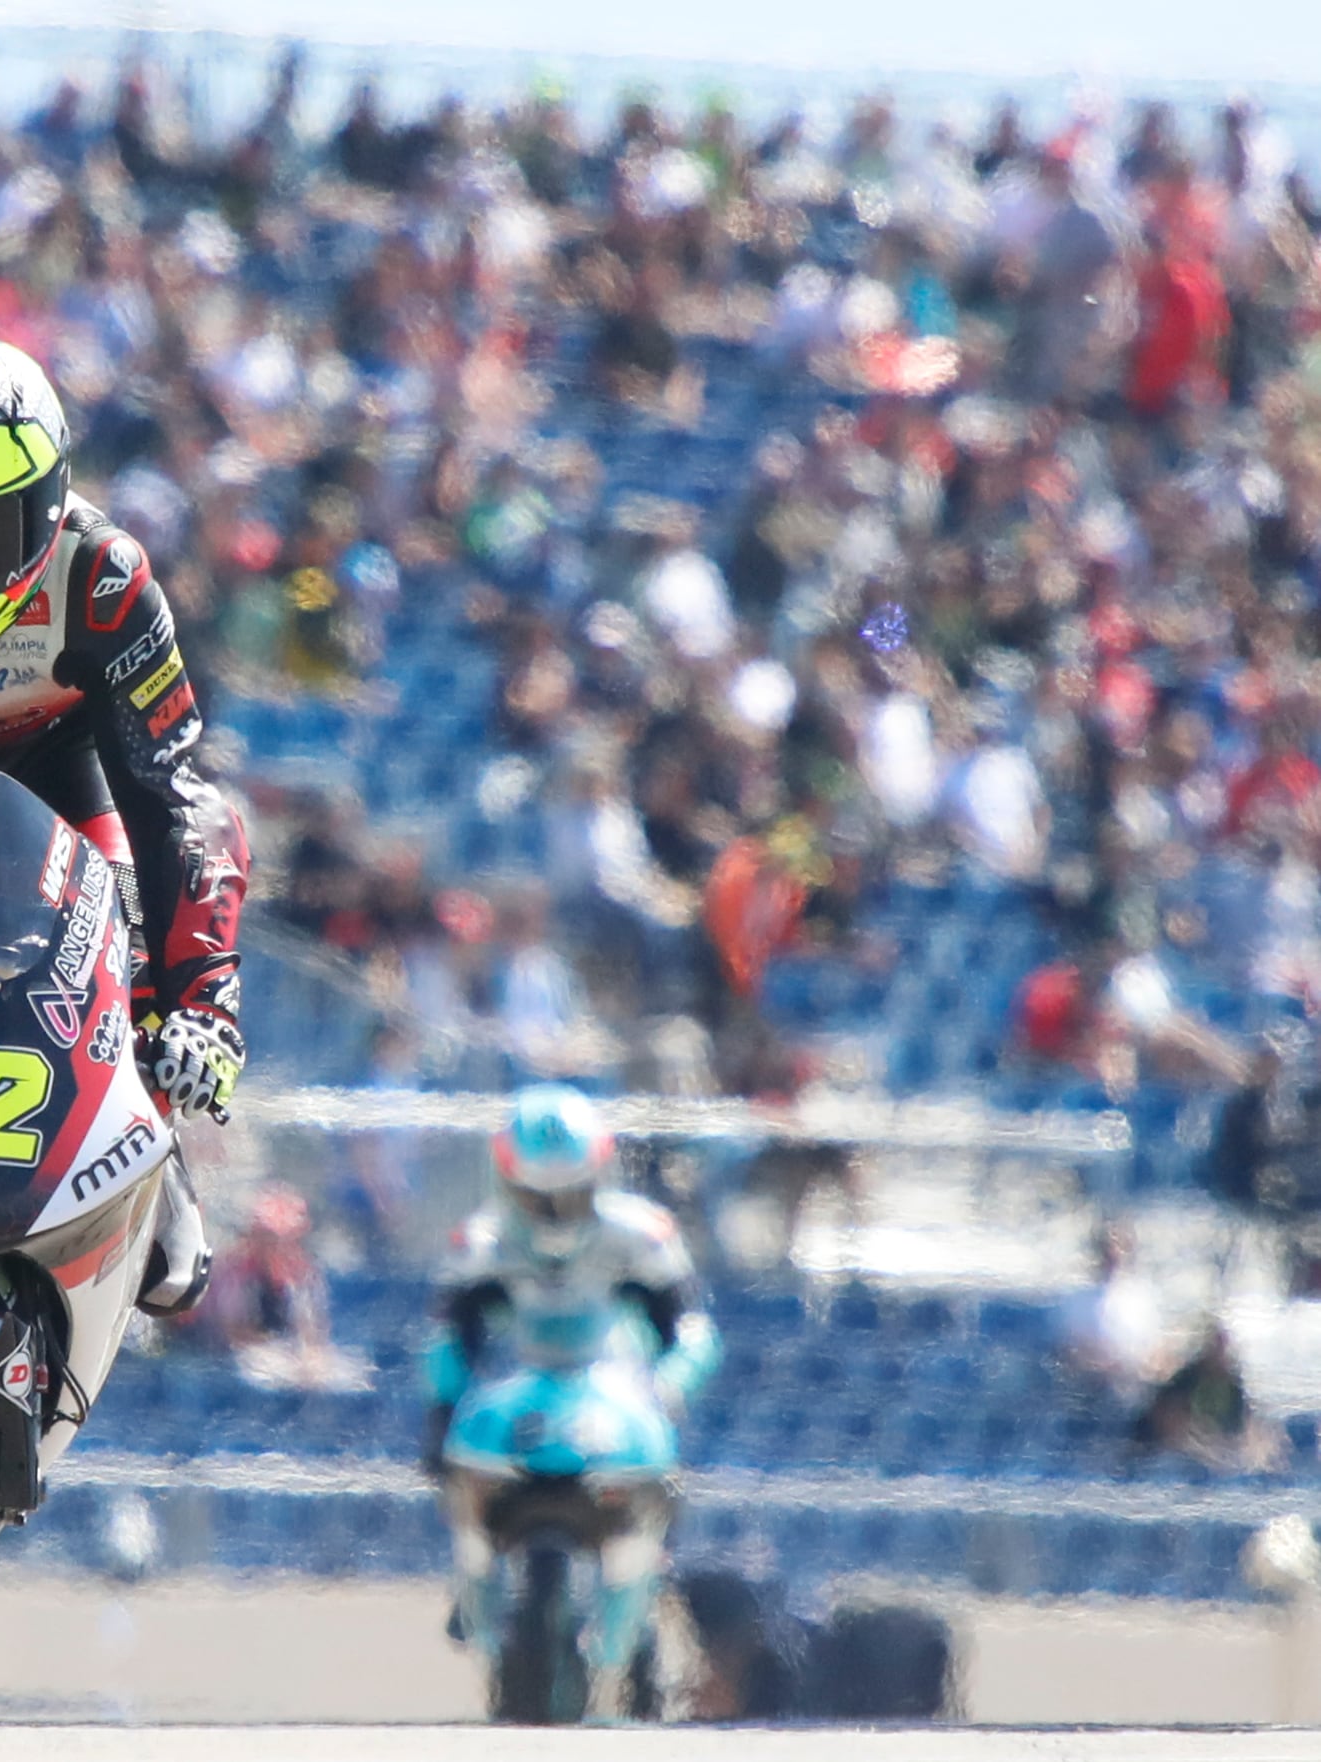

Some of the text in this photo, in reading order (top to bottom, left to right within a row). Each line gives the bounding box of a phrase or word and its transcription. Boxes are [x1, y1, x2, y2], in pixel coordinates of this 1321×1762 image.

[145, 662, 178, 695] DUNL
[42, 822, 73, 904] WRS
[54, 849, 107, 985] ANGELUSS
[6, 1364, 29, 1384] D
